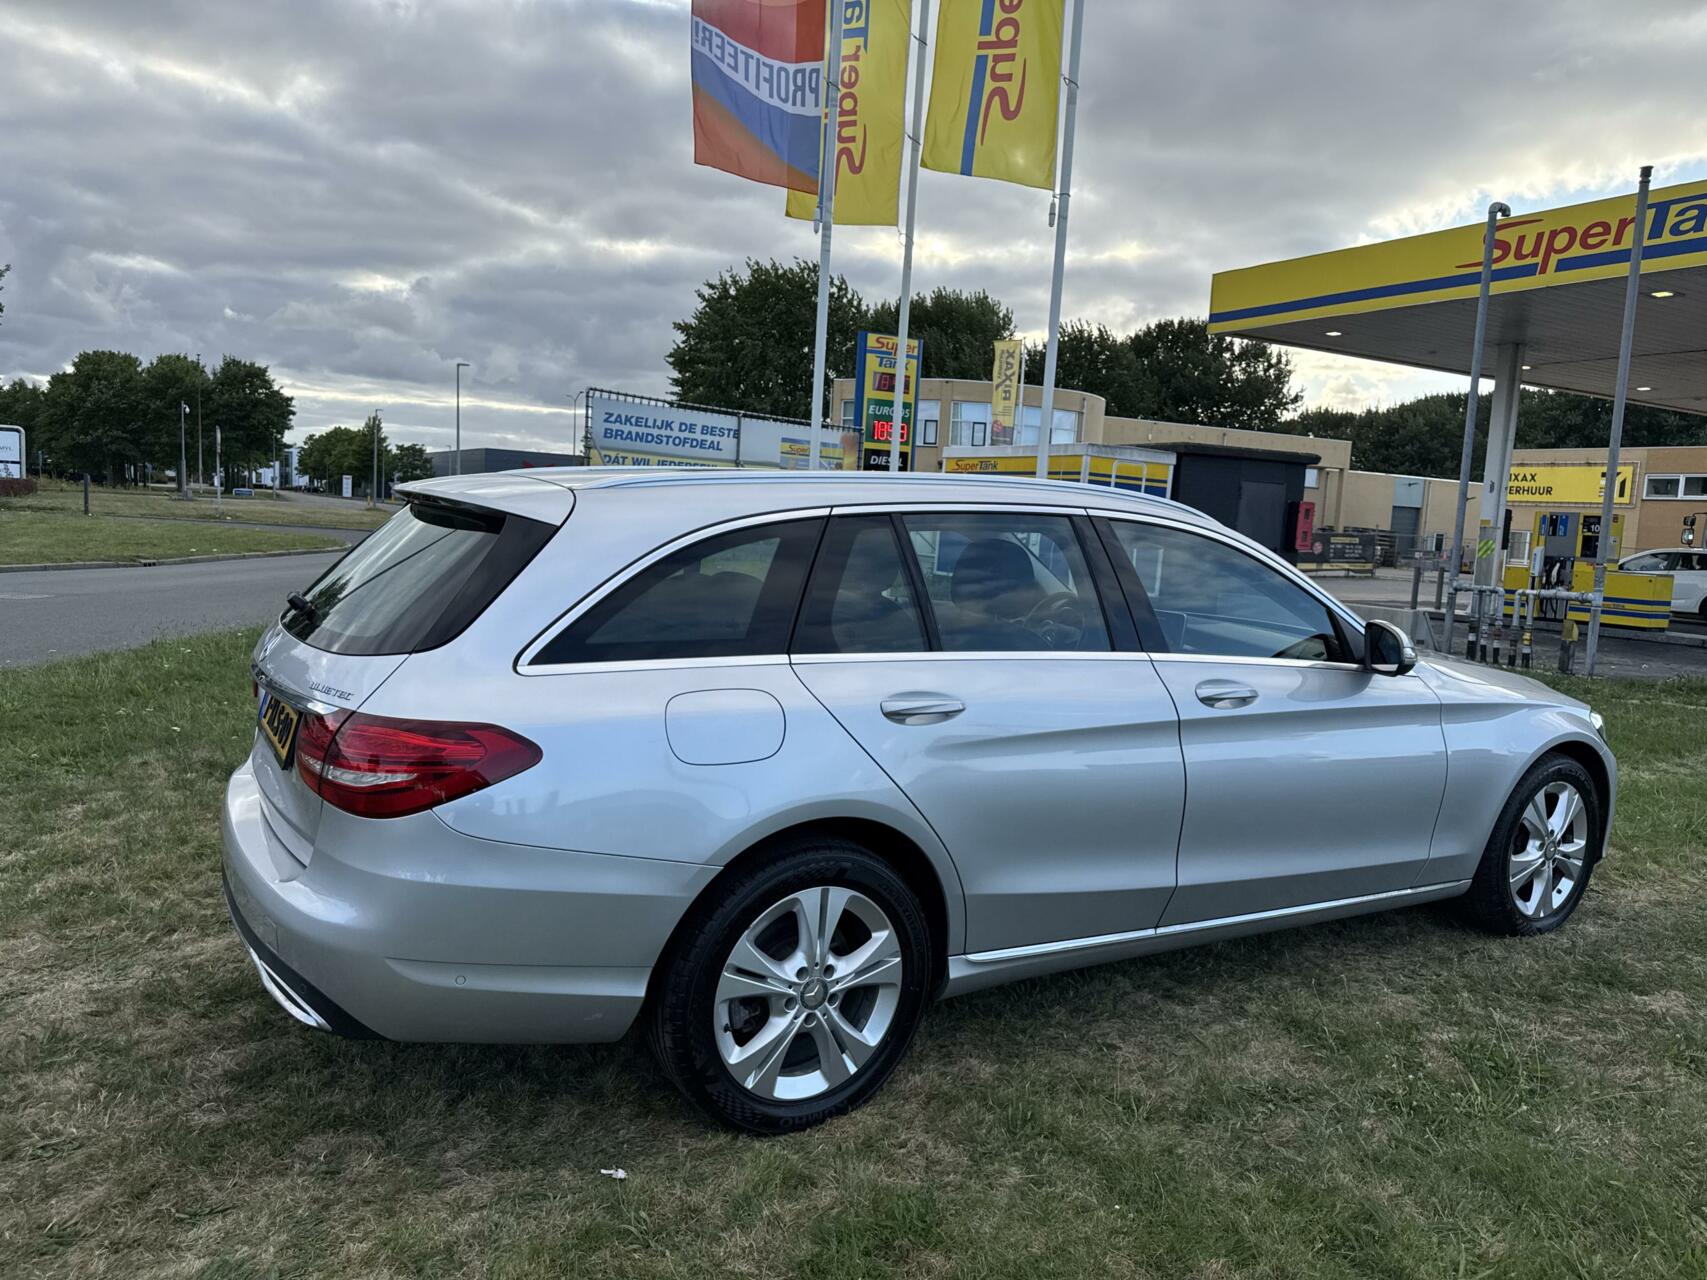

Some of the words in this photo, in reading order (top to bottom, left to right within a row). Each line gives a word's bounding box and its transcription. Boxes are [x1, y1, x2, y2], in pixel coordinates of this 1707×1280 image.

[604, 412, 675, 432] ZAKELIJK
[679, 422, 697, 434] DE
[701, 425, 739, 439] BESTE
[603, 427, 723, 451] BRANDSTOFDEAL
[870, 456, 904, 467] DIEL
[1509, 473, 1537, 482] IXAX
[1508, 486, 1553, 495] ERHUUR
